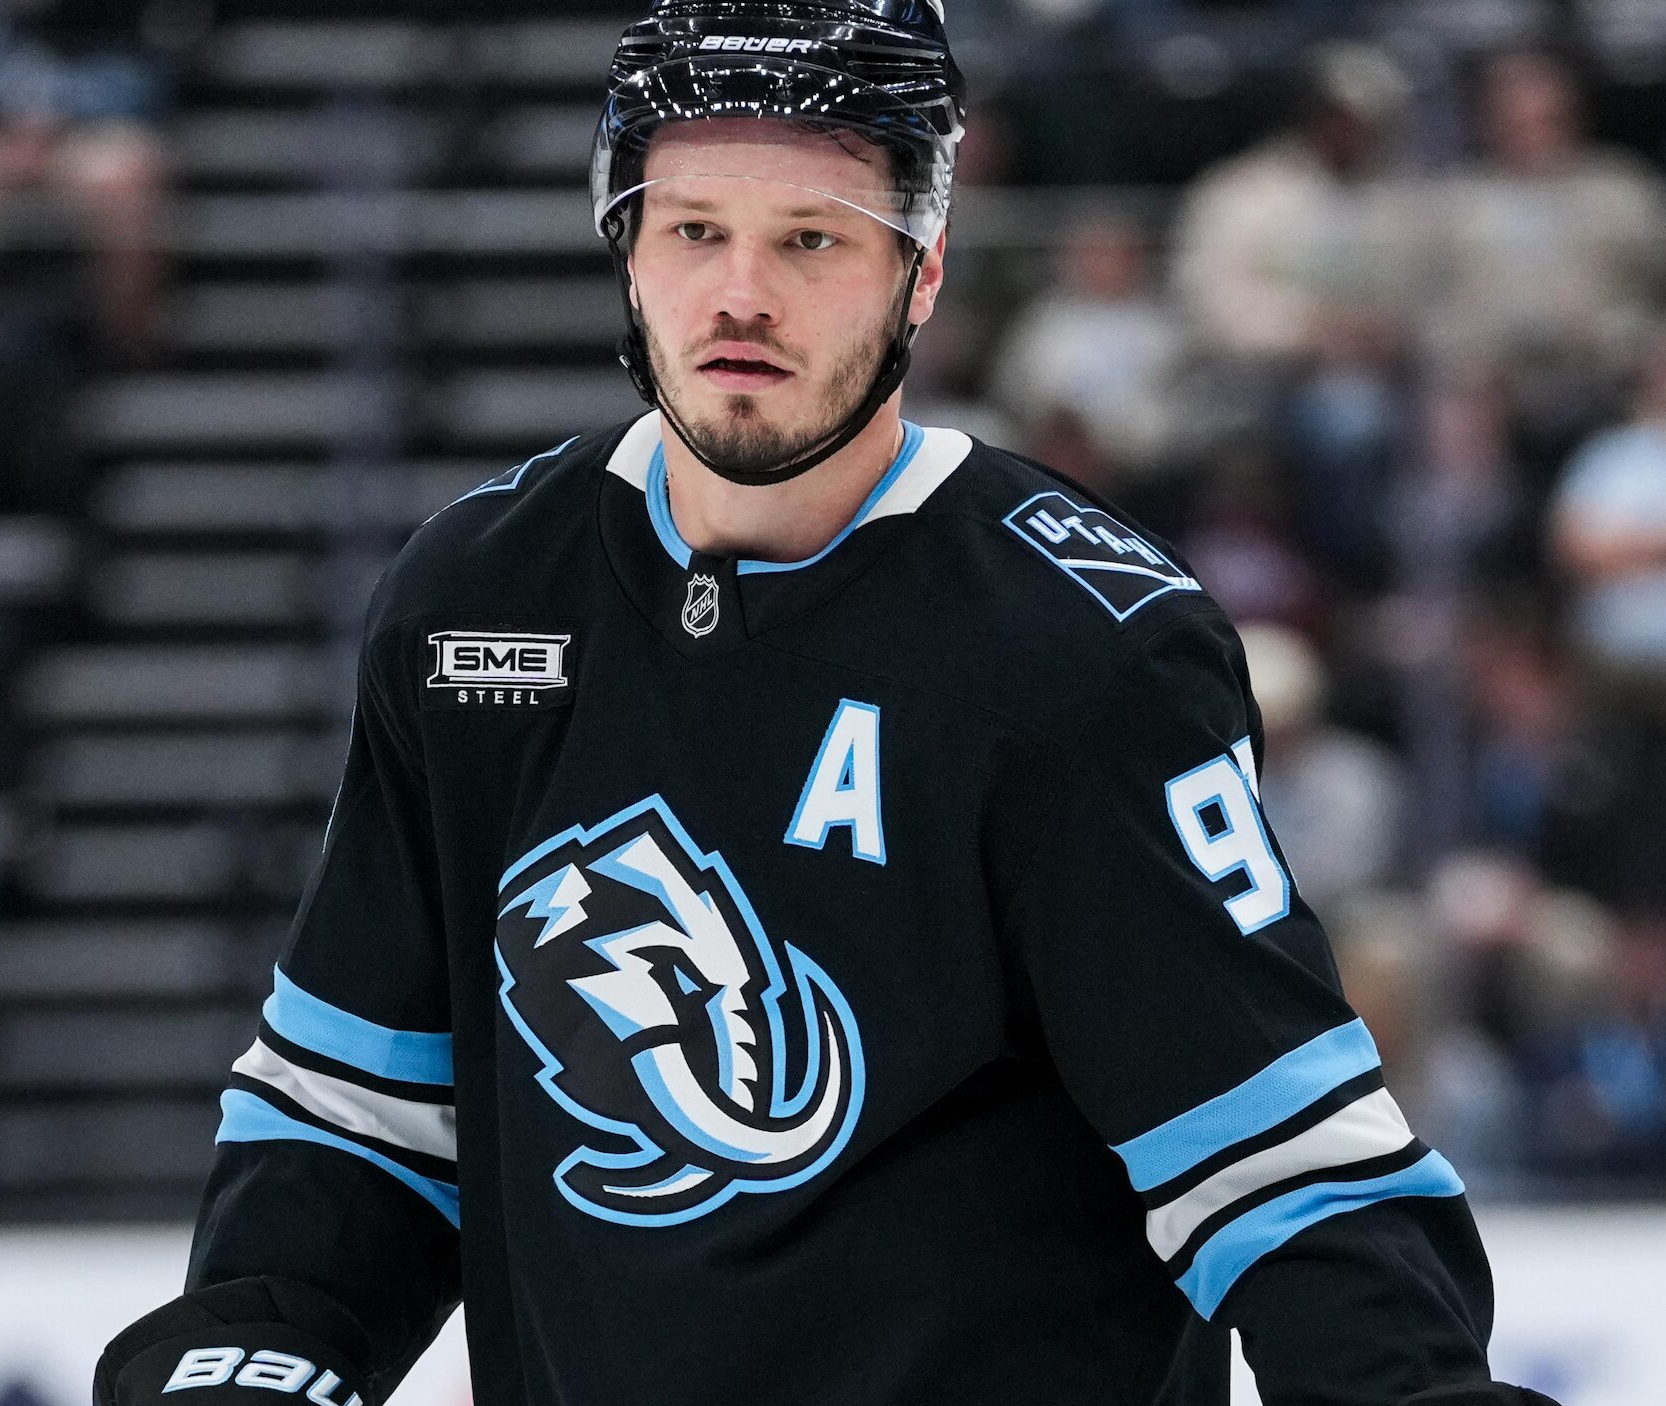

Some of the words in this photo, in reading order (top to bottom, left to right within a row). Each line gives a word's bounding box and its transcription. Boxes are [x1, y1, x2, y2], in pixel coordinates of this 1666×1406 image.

[1025, 508, 1164, 566] UTAH
[689, 592, 713, 623] NHL
[453, 646, 547, 672] SME
[457, 690, 539, 705] STEEL
[783, 698, 887, 866] A
